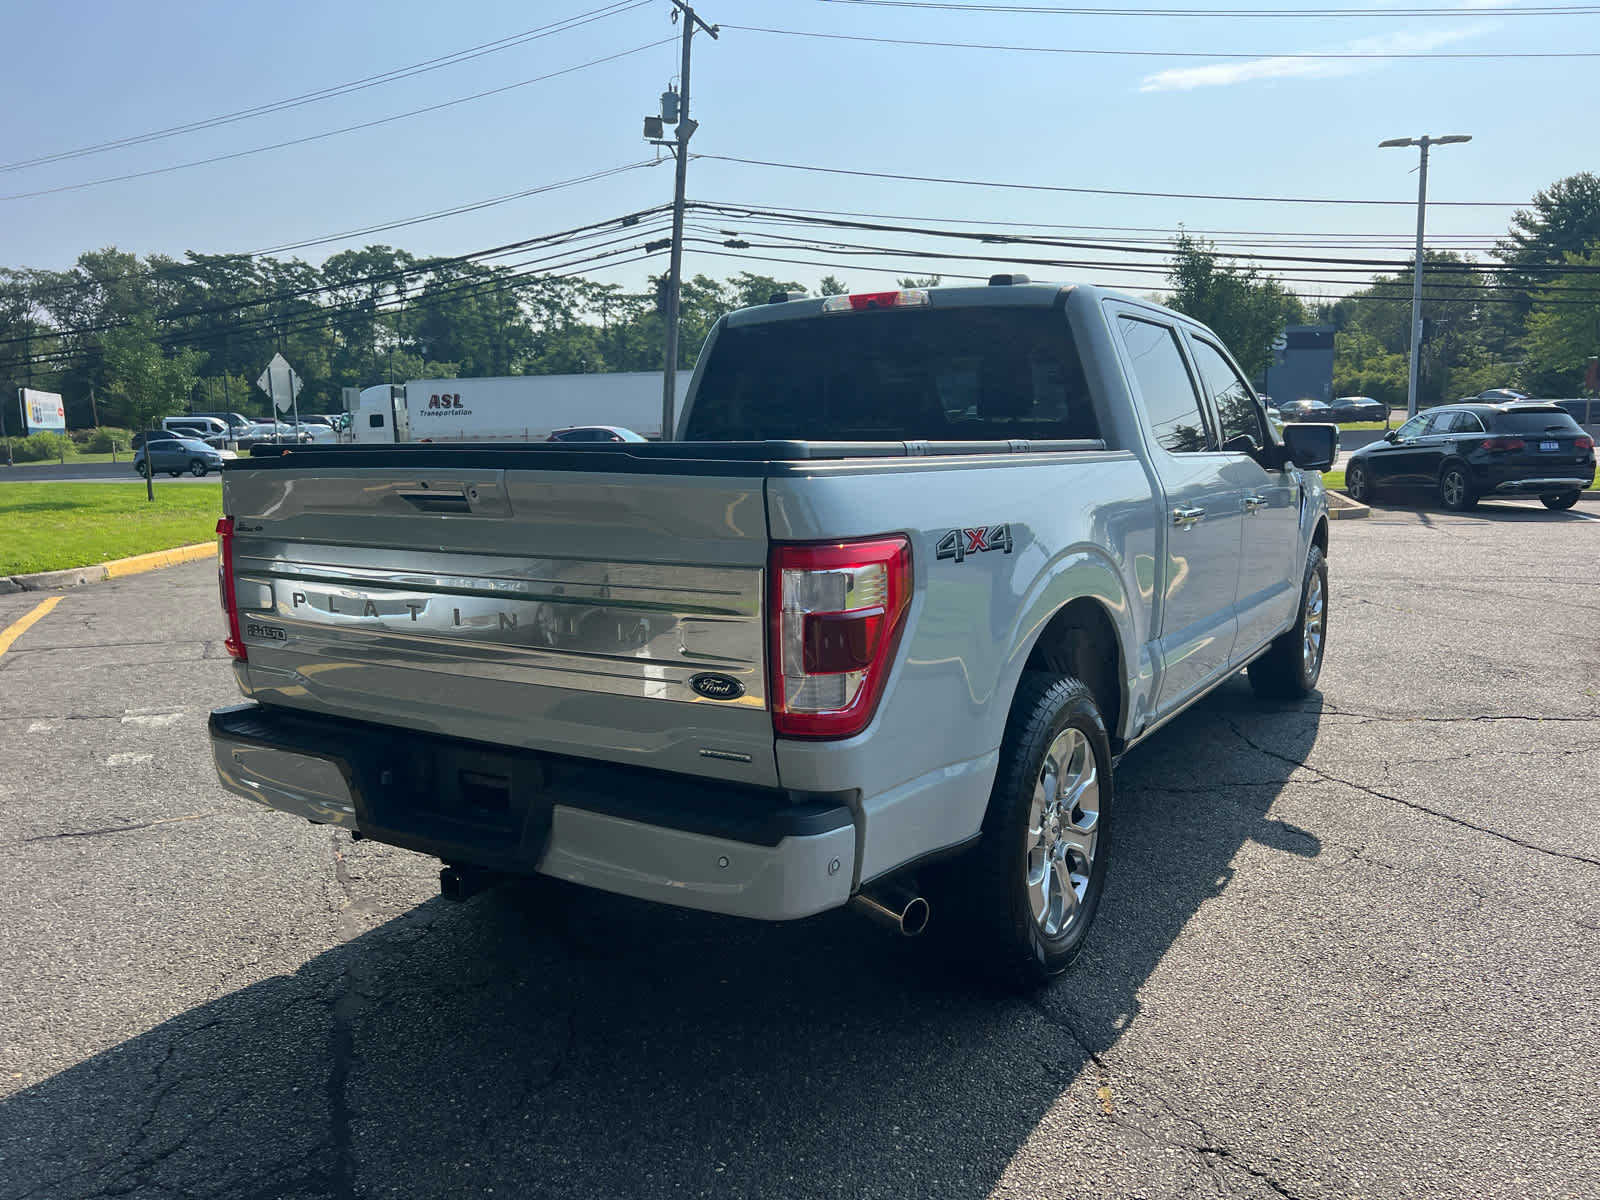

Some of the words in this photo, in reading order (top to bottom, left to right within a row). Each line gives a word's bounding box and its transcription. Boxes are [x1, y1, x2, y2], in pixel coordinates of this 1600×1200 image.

[428, 393, 464, 409] ASL
[420, 409, 473, 417] Transportation
[292, 592, 649, 642] PLATINUM
[697, 677, 731, 694] Ford
